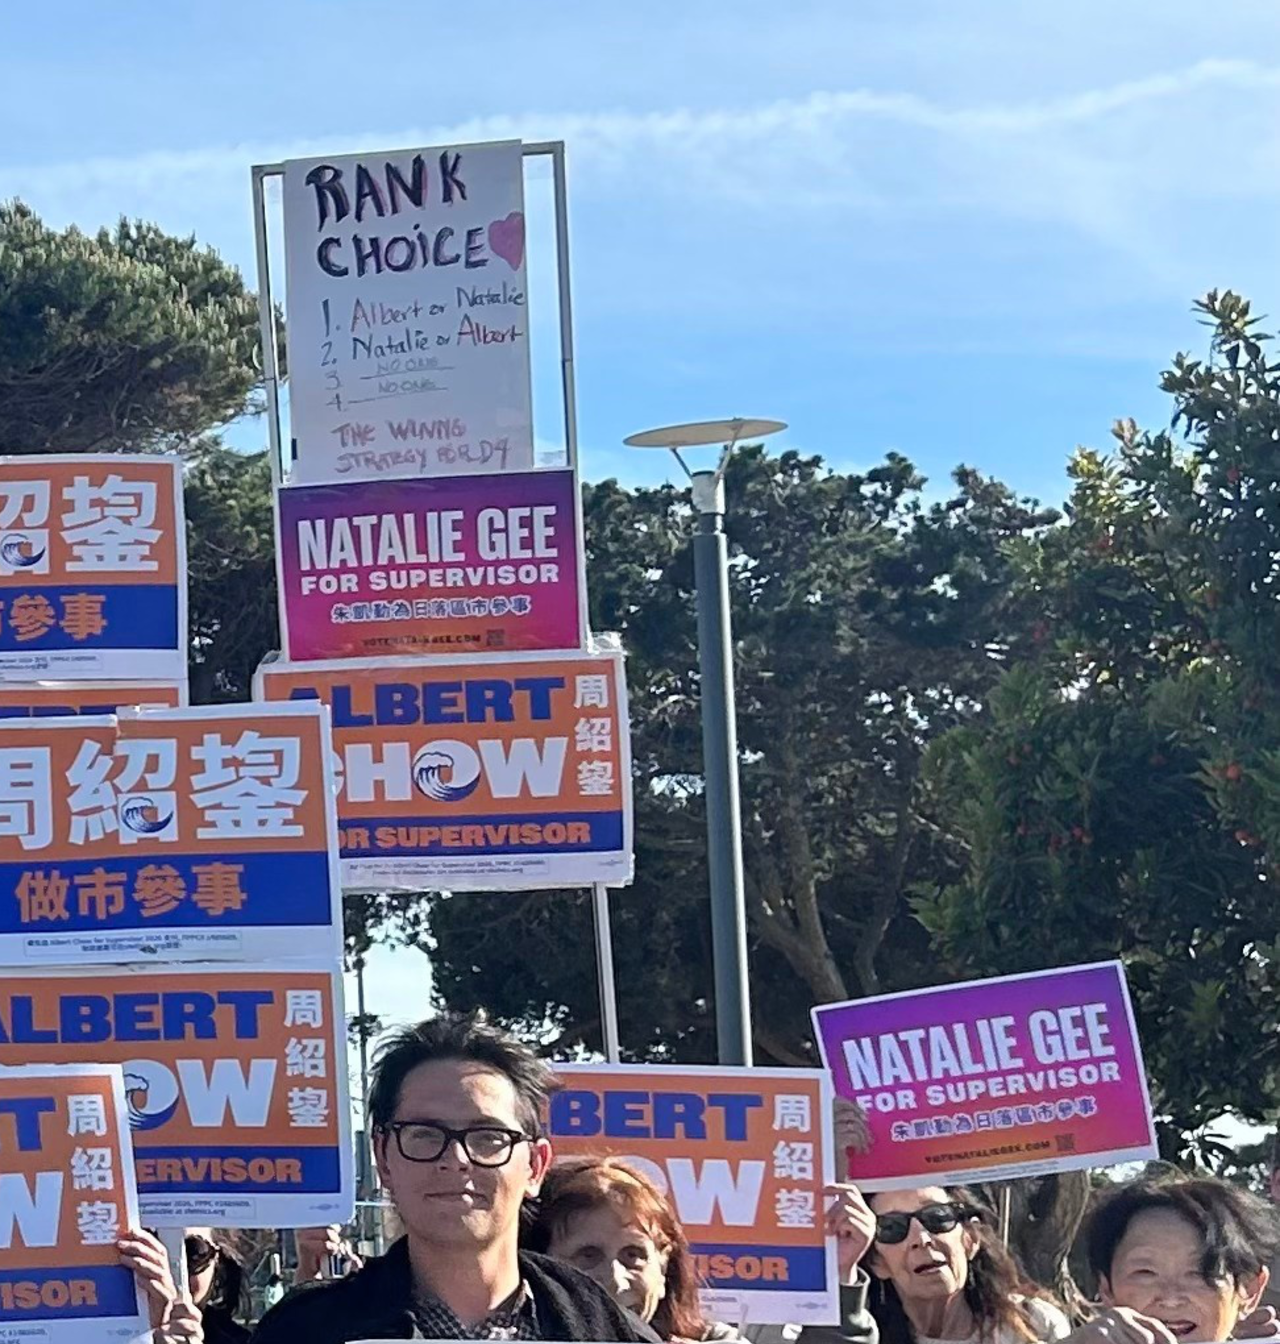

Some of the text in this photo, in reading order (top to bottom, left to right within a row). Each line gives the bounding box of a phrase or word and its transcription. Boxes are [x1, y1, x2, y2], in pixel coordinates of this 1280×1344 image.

[305, 150, 467, 232] RANK
[321, 284, 526, 338] 1. Albert or Natalie
[320, 313, 524, 367] 2. Natalie or Albert
[297, 505, 559, 572] NATALIE GEE
[301, 562, 560, 596] FOR SUPERVISOR
[332, 736, 569, 802] HOW
[375, 822, 591, 850] SUPERVISOR
[14, 862, 249, 923] 做市參事
[842, 1002, 1117, 1091] NATALIE GEE
[856, 1061, 1121, 1113] FOR SUPERVISOR
